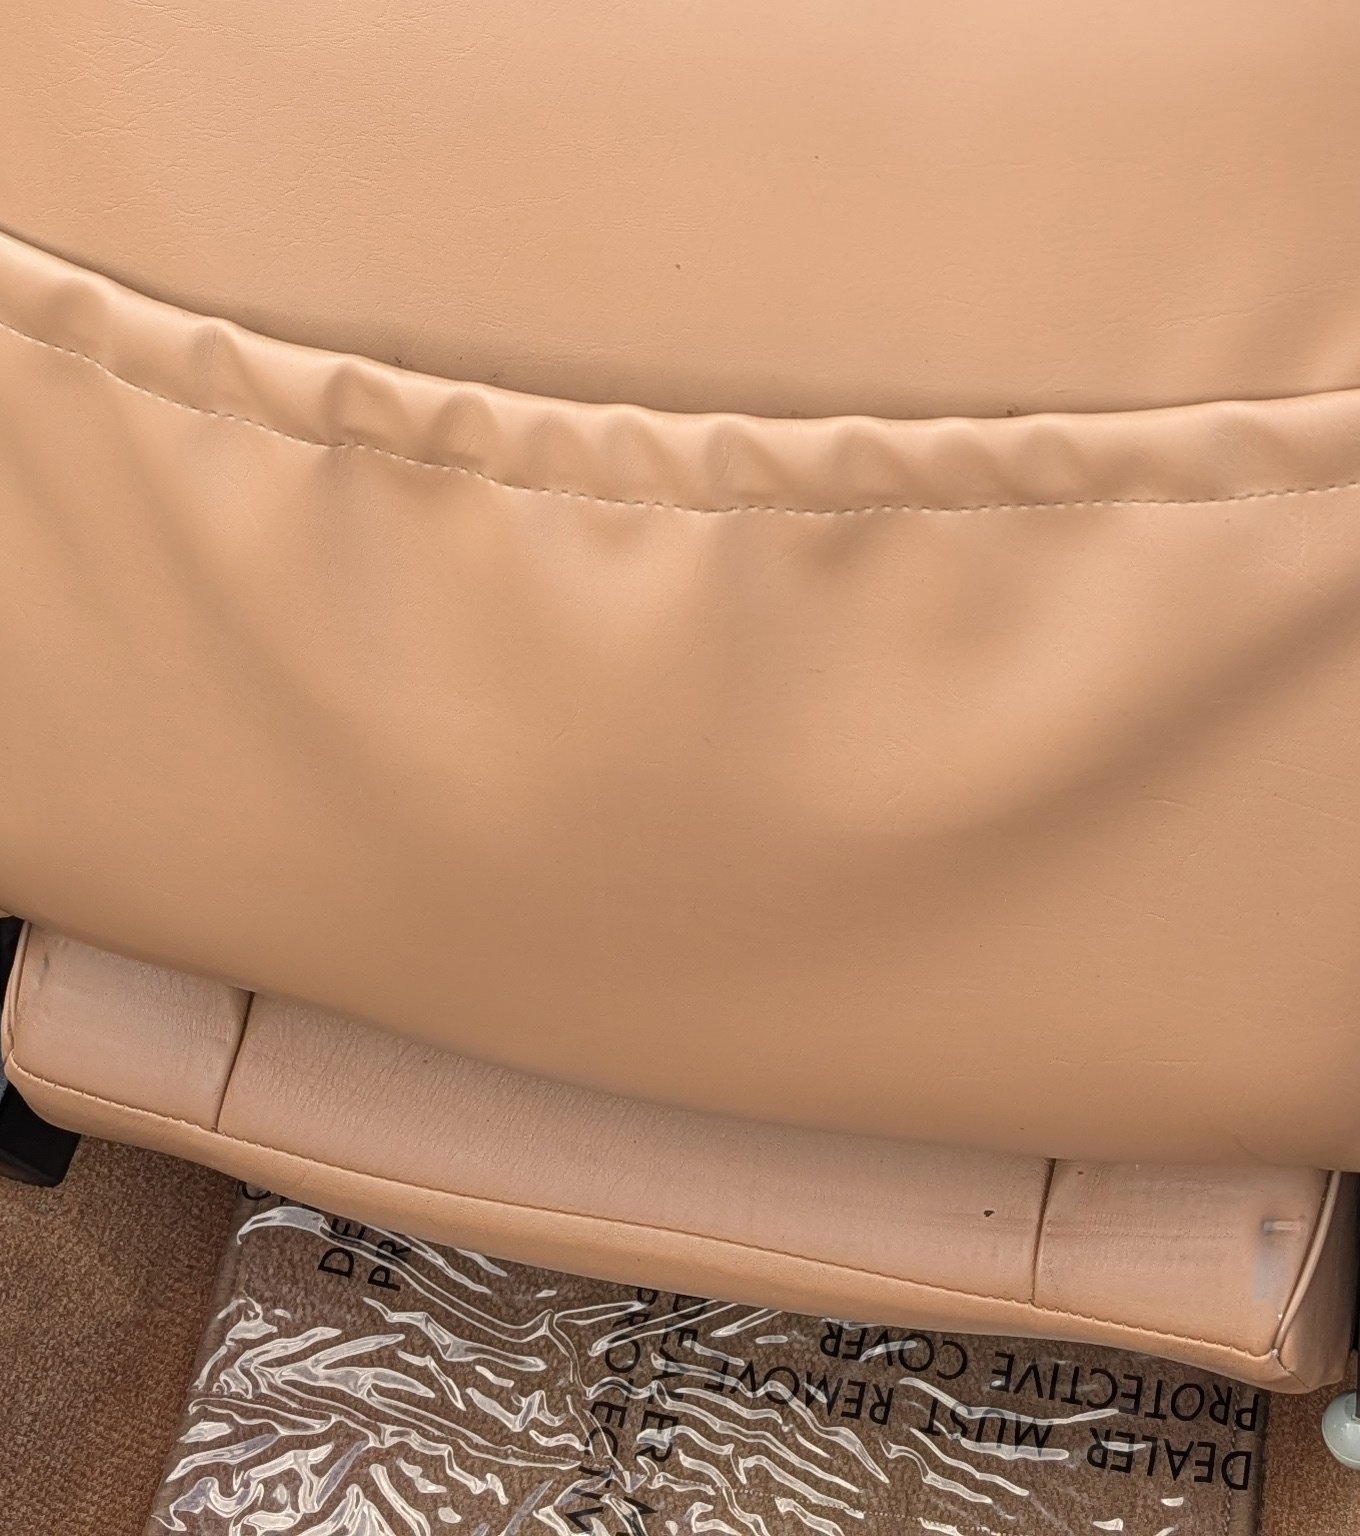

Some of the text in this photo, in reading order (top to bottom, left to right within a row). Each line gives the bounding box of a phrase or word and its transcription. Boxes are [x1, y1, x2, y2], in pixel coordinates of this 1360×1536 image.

[703, 1358, 1252, 1491] DEALER MUST REMOVE
[819, 1320, 1261, 1431] PROTECTIVE COVER
